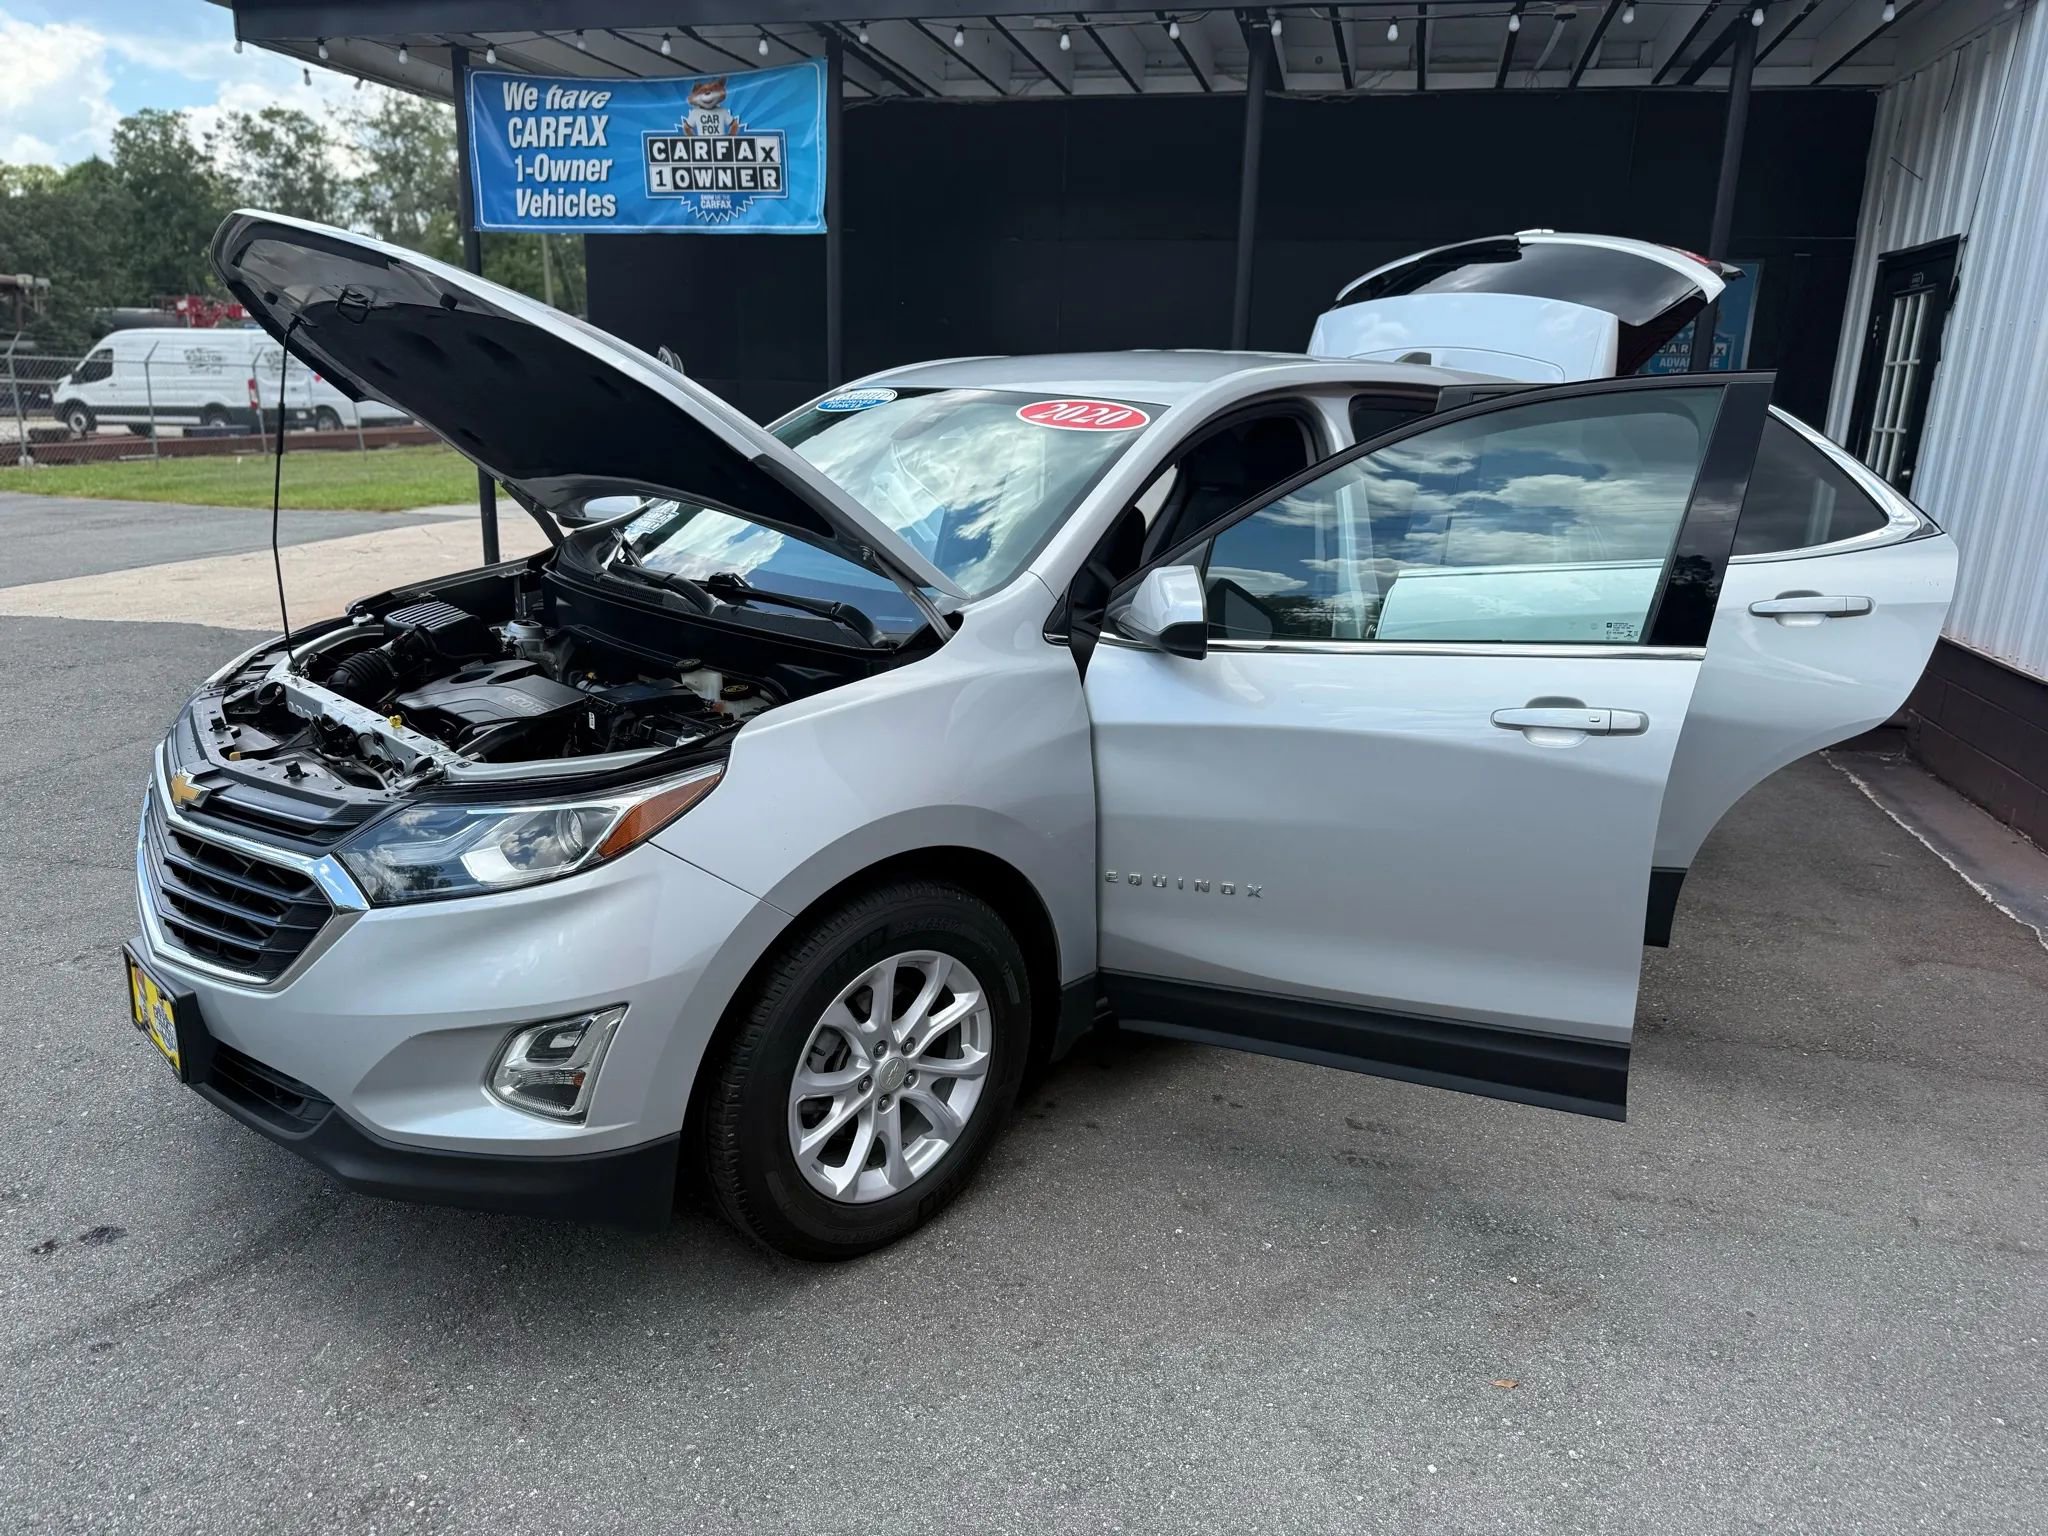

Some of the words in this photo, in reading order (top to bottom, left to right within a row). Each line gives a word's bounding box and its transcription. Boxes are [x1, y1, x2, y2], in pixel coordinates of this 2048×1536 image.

[502, 81, 538, 112] We
[545, 84, 612, 110] have
[508, 115, 609, 149] CARFAX
[700, 114, 720, 125] CAR
[702, 125, 720, 135] FOX
[651, 140, 775, 163] CARFAX
[514, 153, 613, 183] 1-Owner
[516, 187, 617, 218] Vehicles
[700, 200, 732, 209] CARFAX
[1028, 403, 1133, 426] 2020
[1104, 871, 1263, 899] EQUINOX
